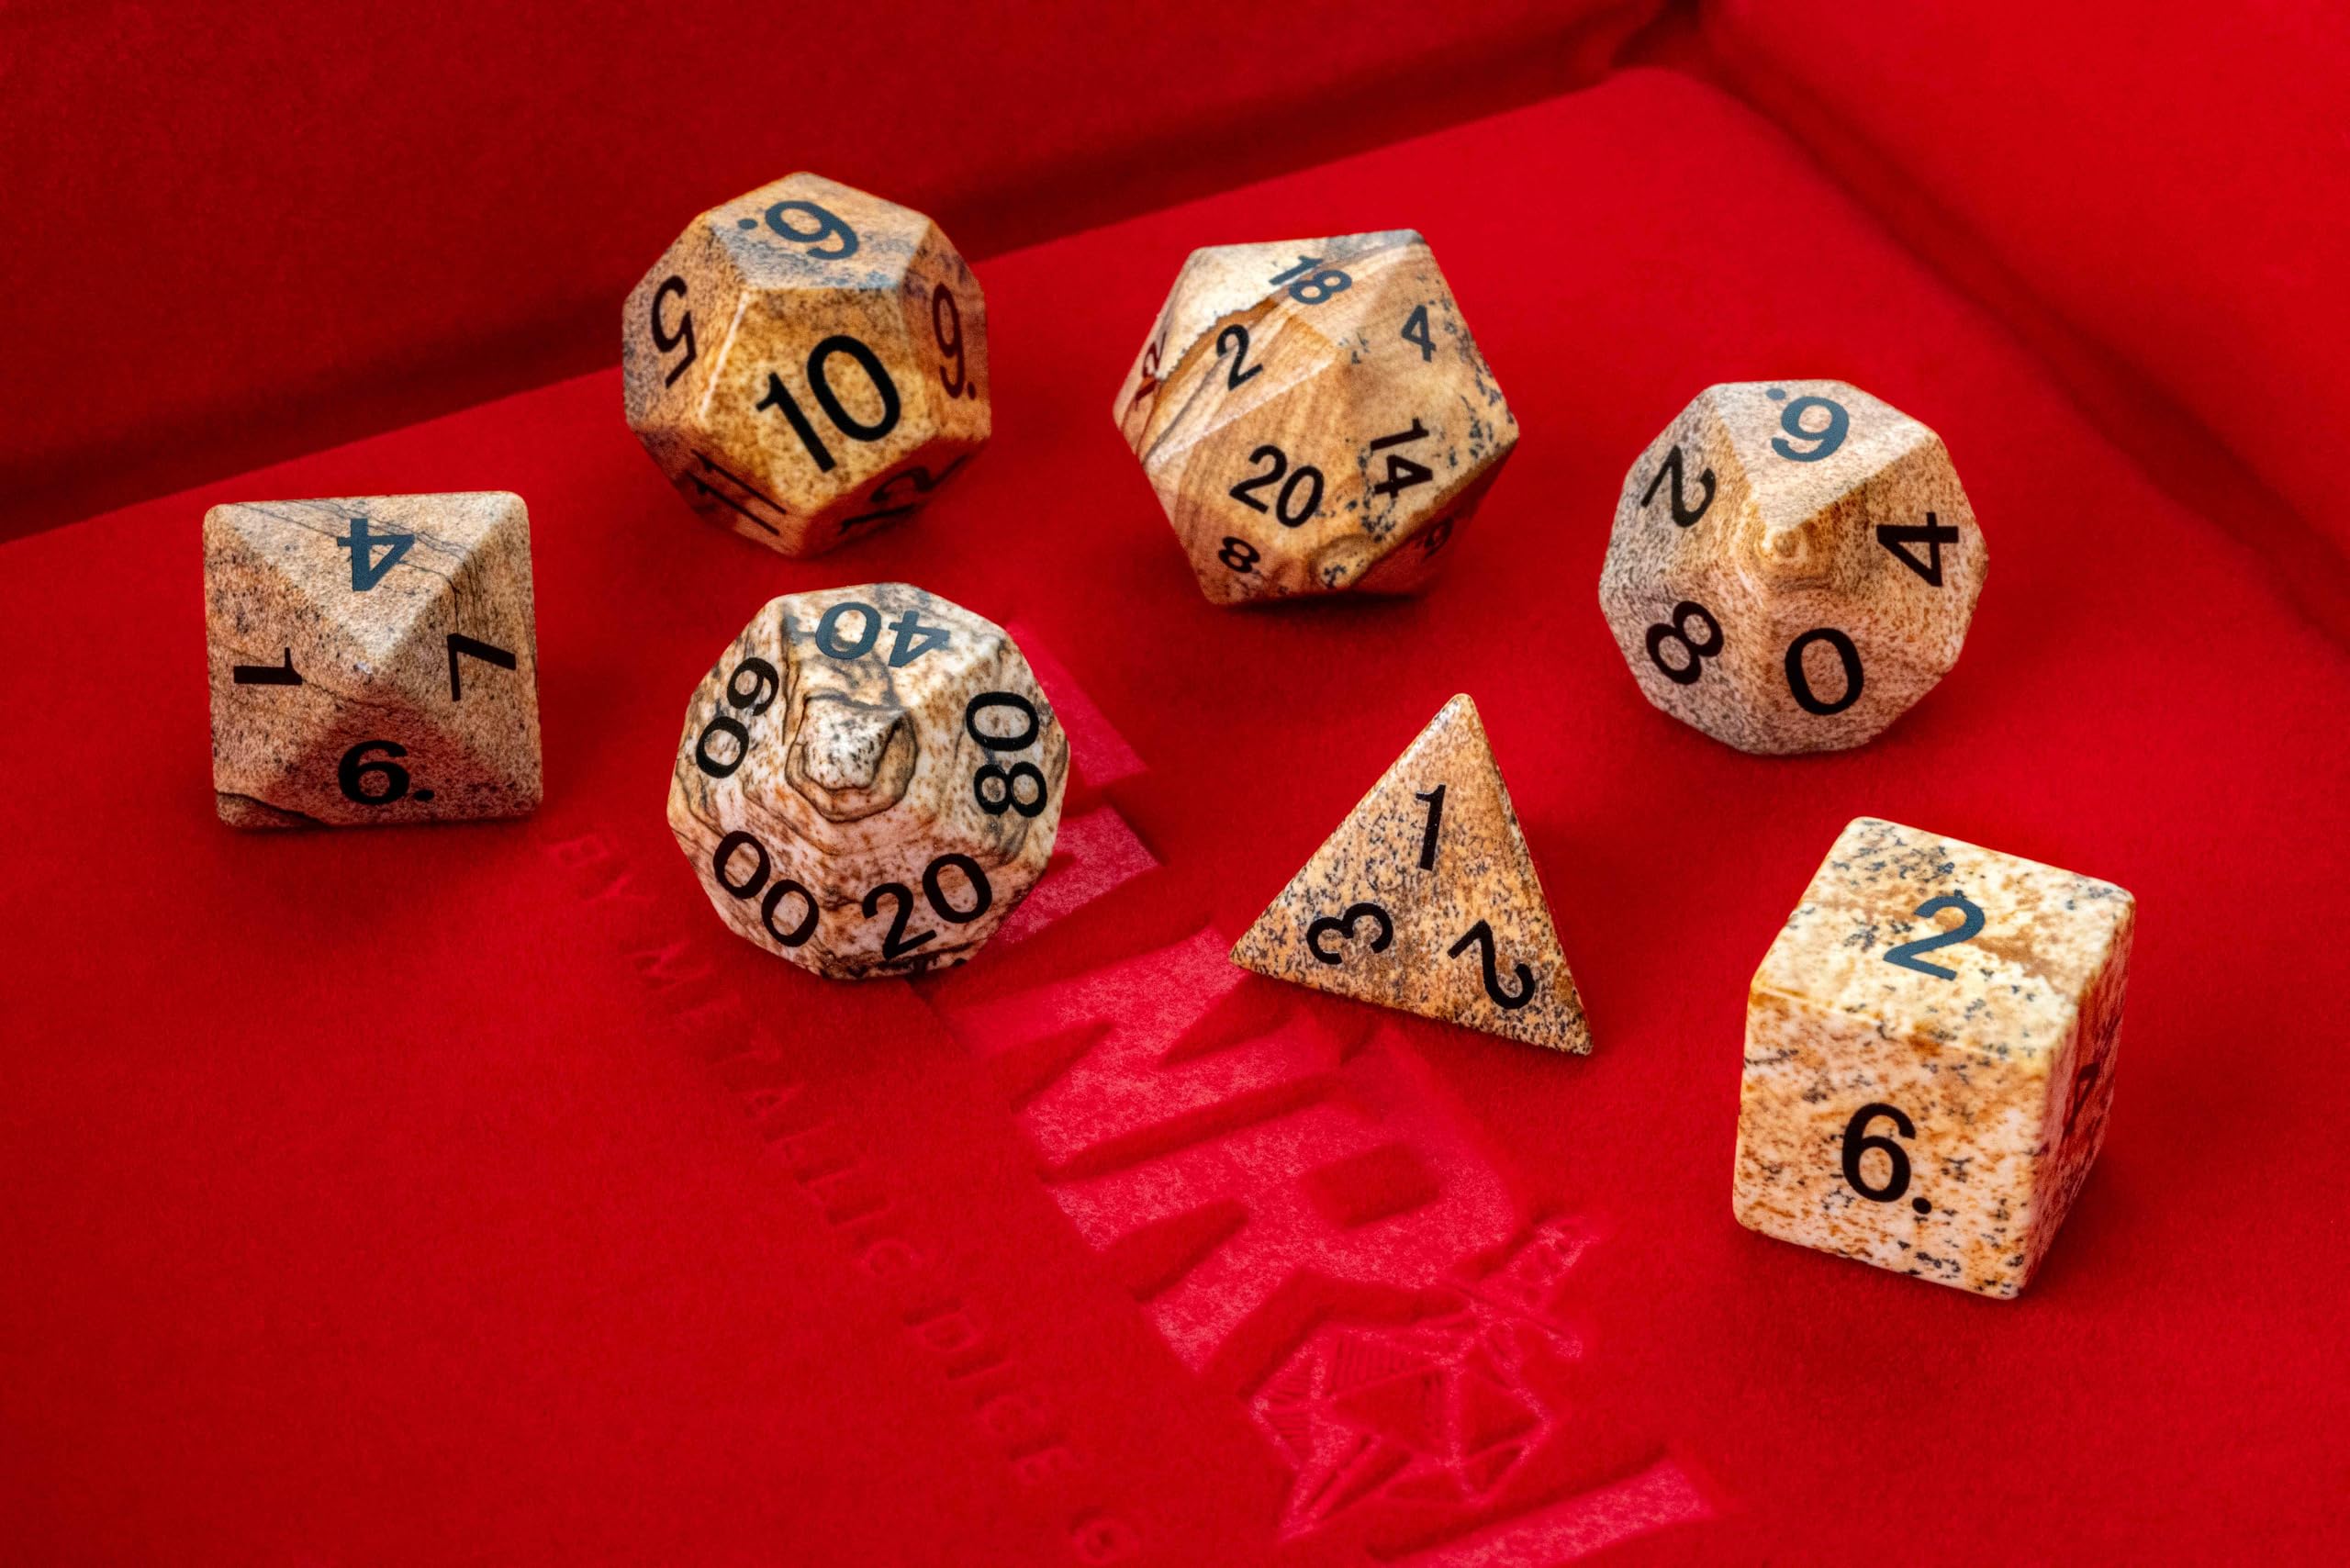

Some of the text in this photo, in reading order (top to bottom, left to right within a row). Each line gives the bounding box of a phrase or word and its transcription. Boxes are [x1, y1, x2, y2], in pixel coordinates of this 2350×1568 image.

[1270, 254, 1353, 306] 18
[650, 274, 699, 390] 5
[1215, 323, 1263, 391] 2
[1400, 305, 1438, 364] 4
[756, 334, 901, 475] 10
[685, 448, 788, 537] 11
[1228, 444, 1325, 529] 20
[1368, 417, 1434, 498] 14
[1639, 444, 1718, 529] 2
[336, 517, 416, 592] 4
[1217, 535, 1261, 574] 8
[1875, 511, 1960, 588] 4
[233, 646, 303, 687] 1
[446, 633, 517, 702] 7
[814, 600, 952, 669] 40
[1645, 599, 1725, 686] 8
[1784, 627, 1865, 717] 0
[695, 655, 780, 779] 60
[965, 689, 1048, 820] 80
[337, 738, 436, 806] 6.
[1416, 782, 1447, 871] 1
[711, 829, 820, 948] 00
[861, 852, 994, 961] 20
[1305, 901, 1393, 967] 3
[1448, 918, 1536, 1011] 2
[1882, 895, 1986, 981] 2
[547, 830, 657, 902] BY
[900, 1296, 1083, 1487] DICE
[1841, 1102, 1934, 1216] 6.
